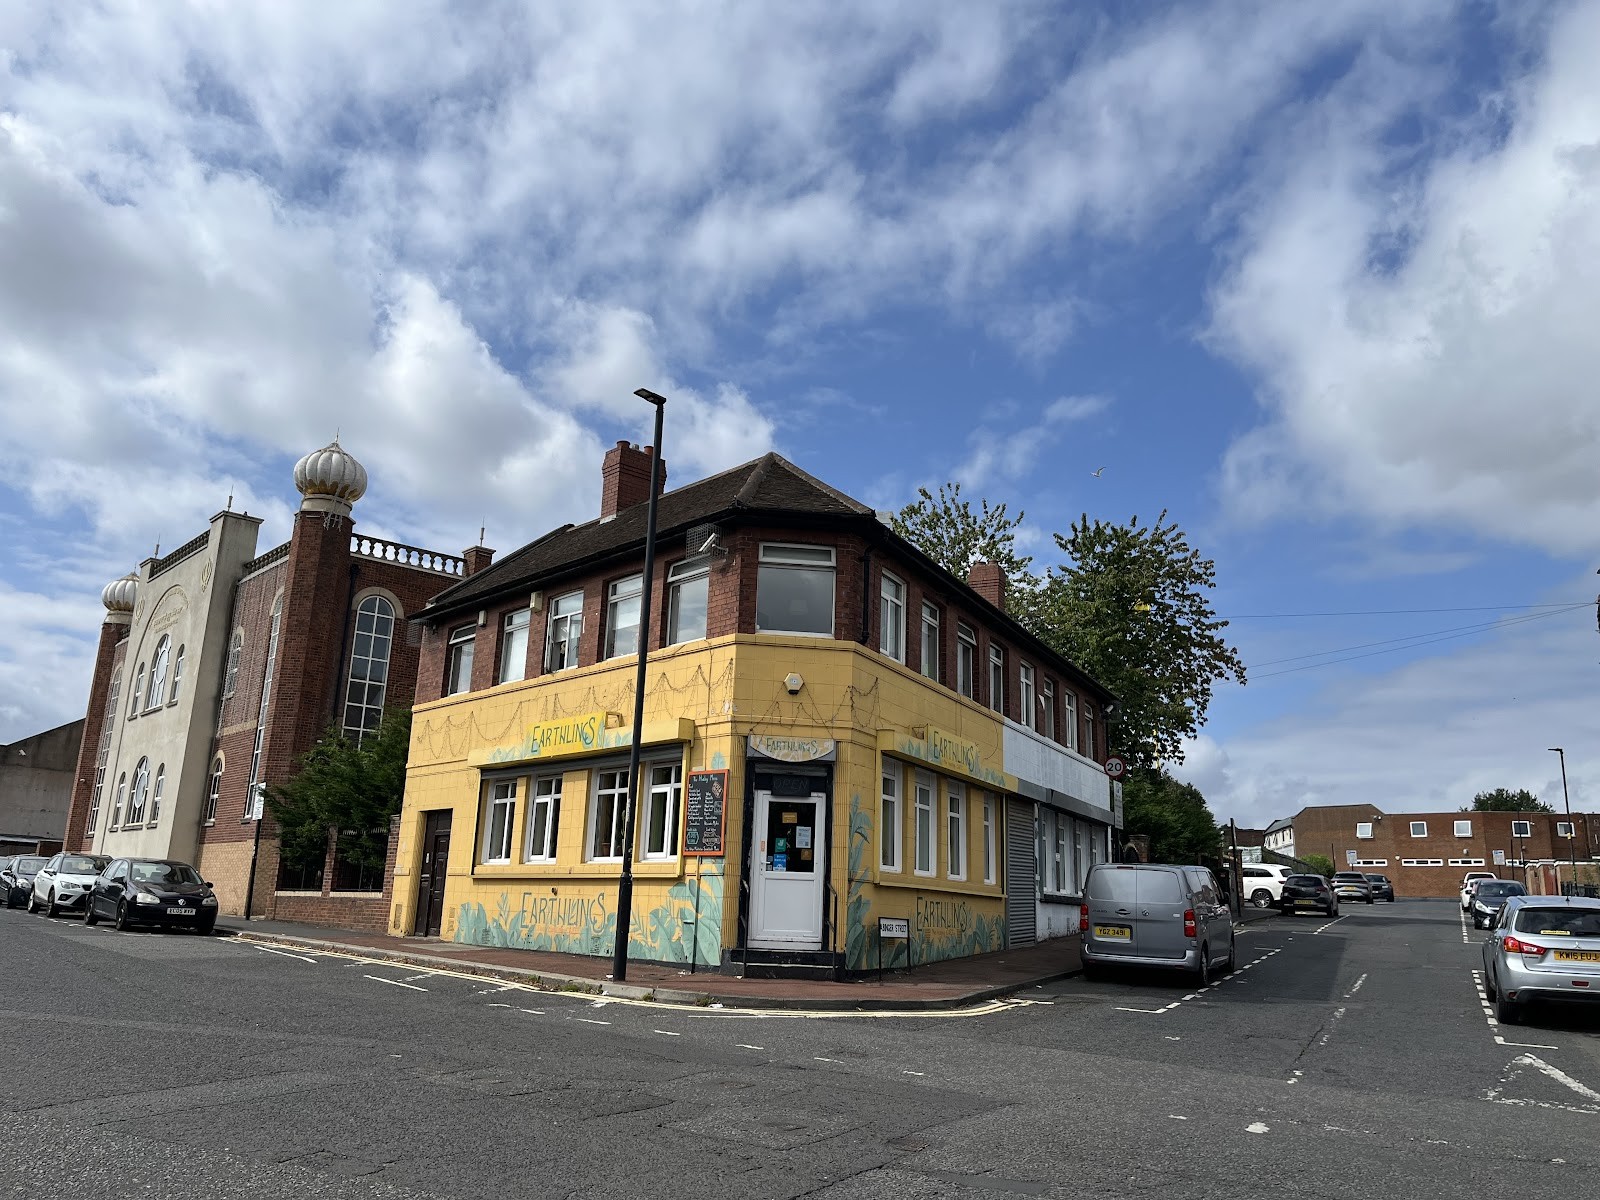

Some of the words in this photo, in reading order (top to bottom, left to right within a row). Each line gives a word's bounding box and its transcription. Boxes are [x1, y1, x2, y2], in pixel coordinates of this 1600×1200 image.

[531, 717, 596, 753] EARTHLINGS
[934, 730, 975, 772] EARTHLINGS
[1107, 762, 1122, 772] 20
[520, 892, 606, 934] EARTHLINGS
[895, 924, 907, 933] STREET
[916, 896, 968, 933] EARTHLINGS
